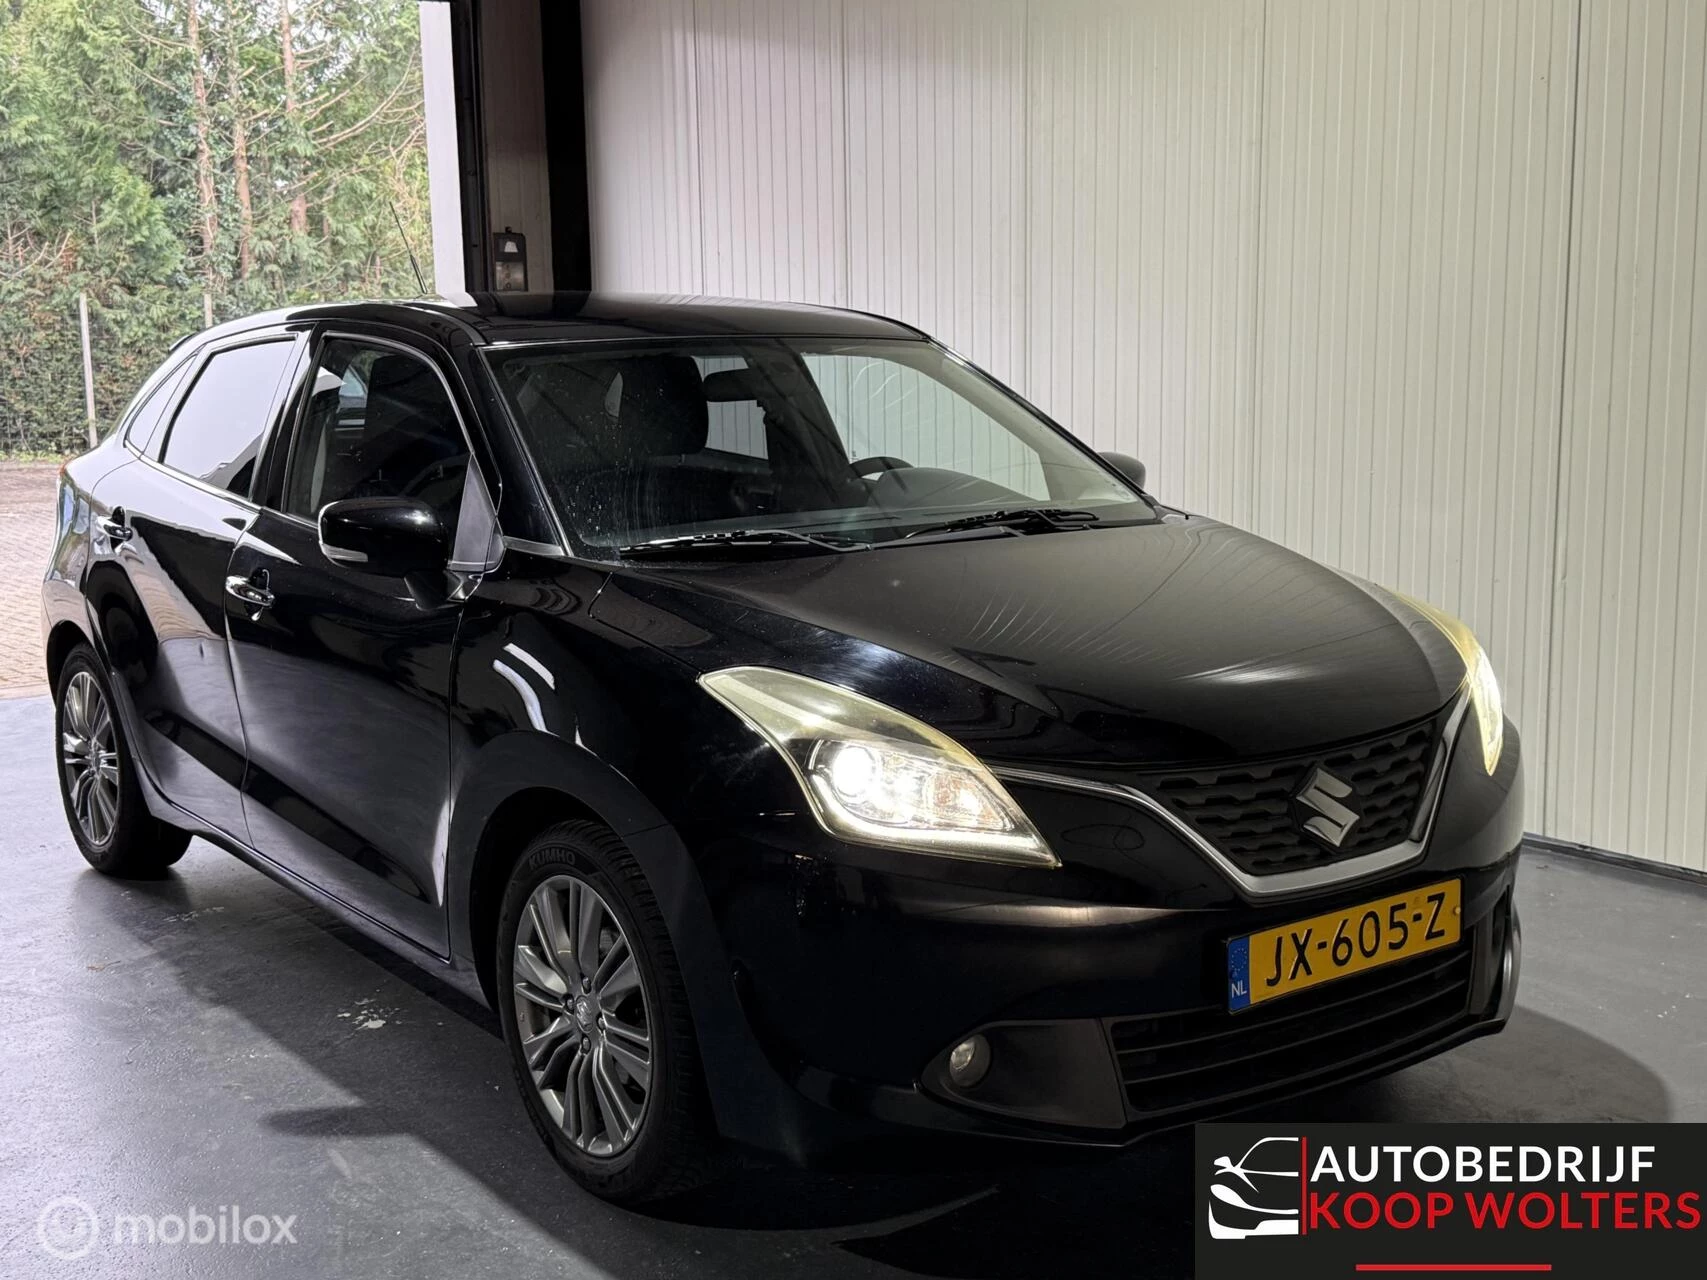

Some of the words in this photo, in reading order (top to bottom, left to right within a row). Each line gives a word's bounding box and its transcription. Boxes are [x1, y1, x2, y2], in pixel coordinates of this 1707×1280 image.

[529, 848, 575, 870] KUMHO
[1264, 892, 1446, 987] JX-605-Z
[1231, 981, 1247, 998] NL
